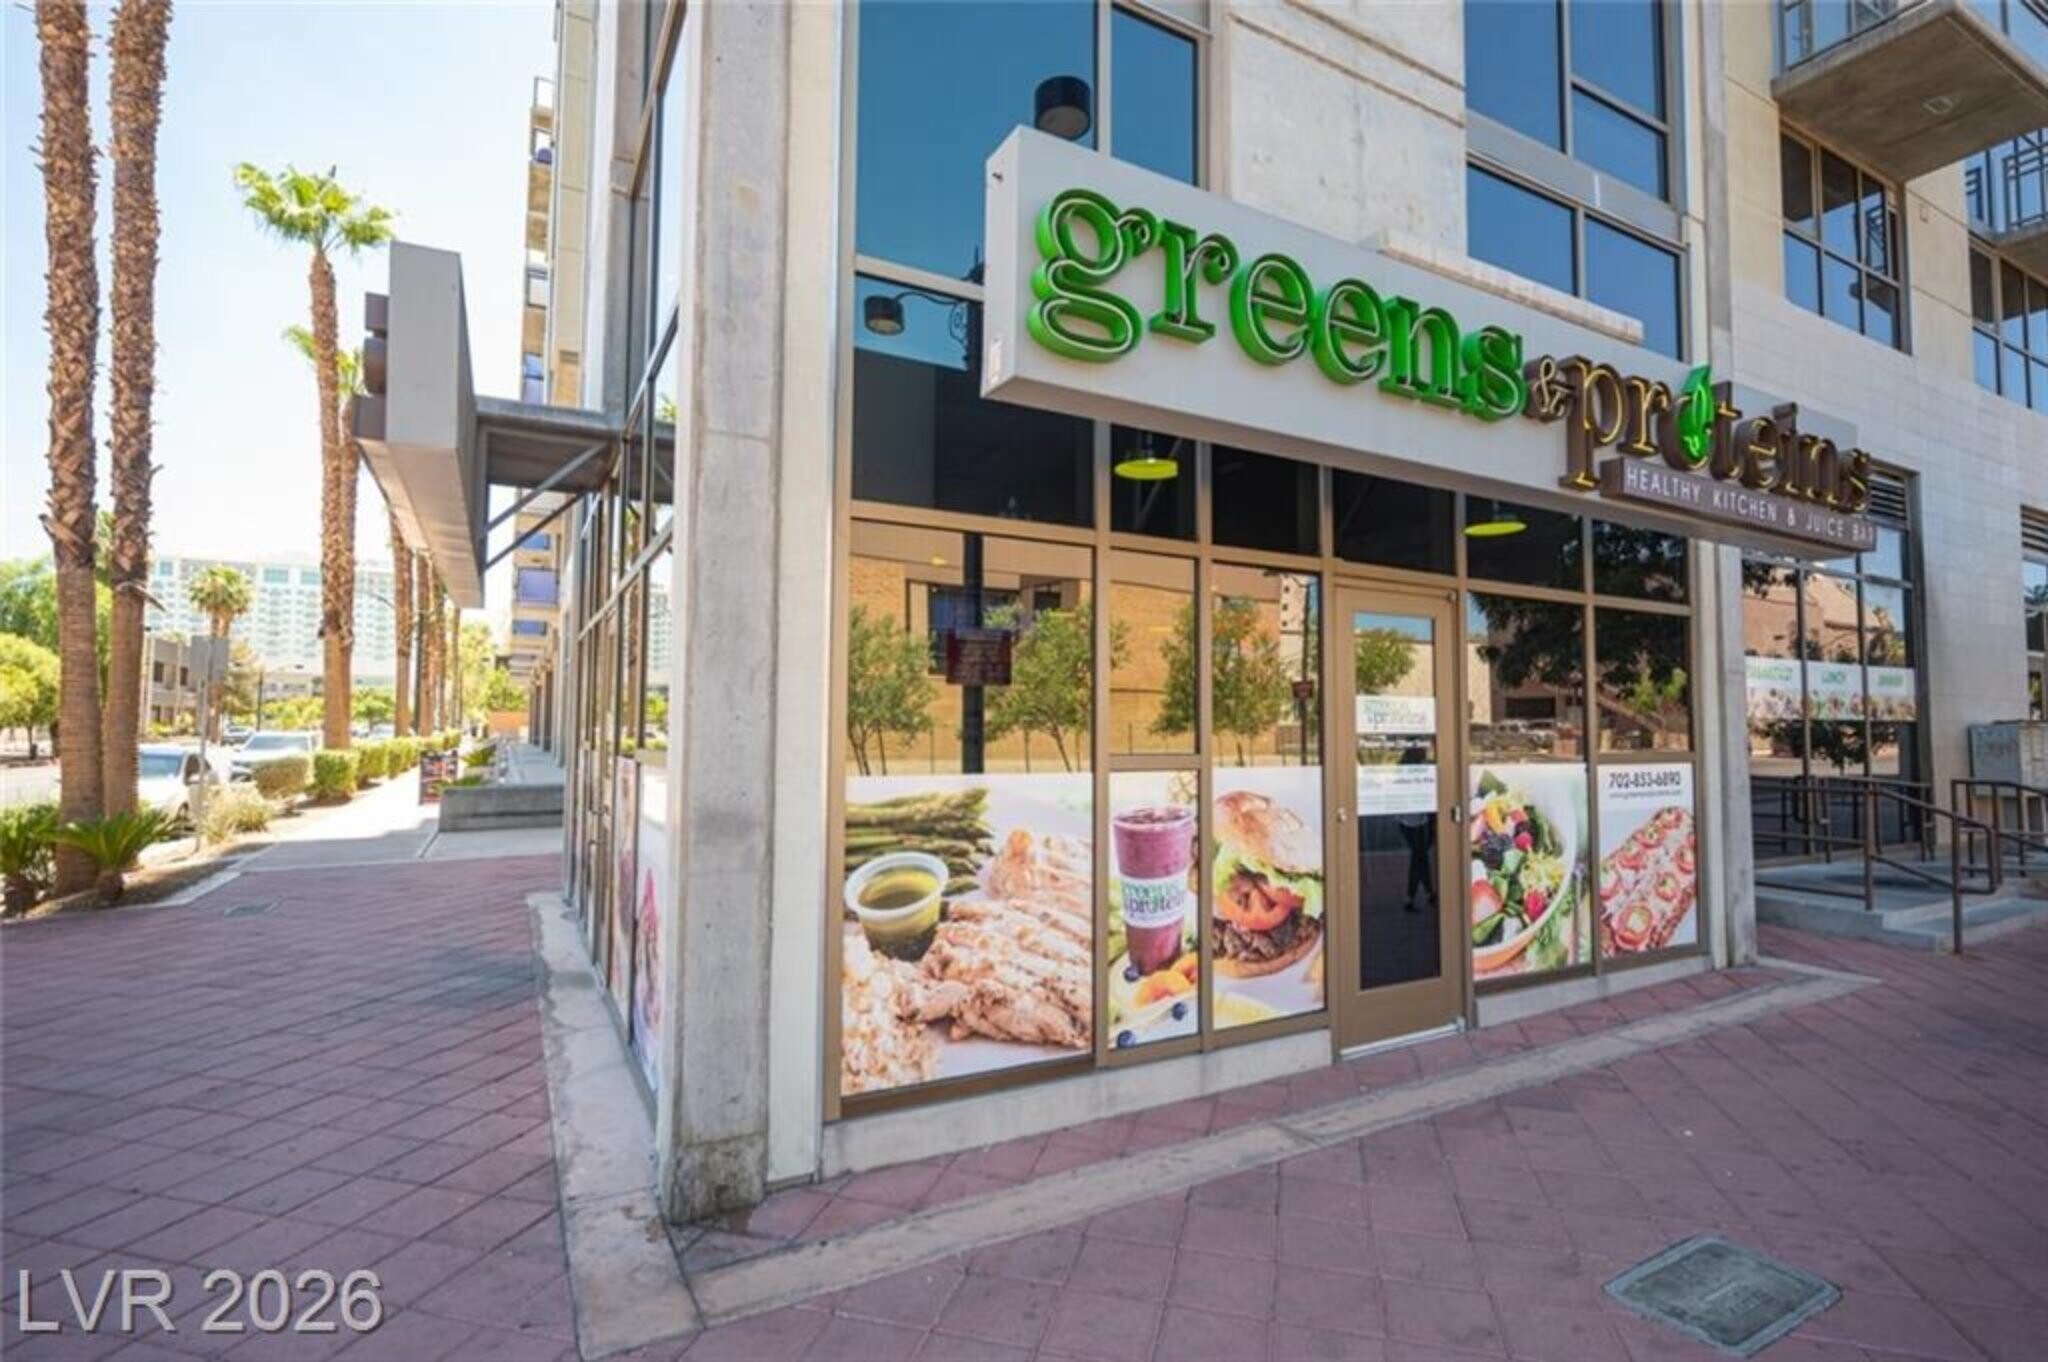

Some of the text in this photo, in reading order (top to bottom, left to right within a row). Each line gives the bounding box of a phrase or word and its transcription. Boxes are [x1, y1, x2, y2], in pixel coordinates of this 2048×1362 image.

[1027, 188, 1872, 513] greens & proteins
[1626, 466, 1700, 503] HEALTHY
[1712, 489, 1777, 523] KITCHEN
[1787, 512, 1797, 528] &
[1806, 511, 1844, 538] JUICE
